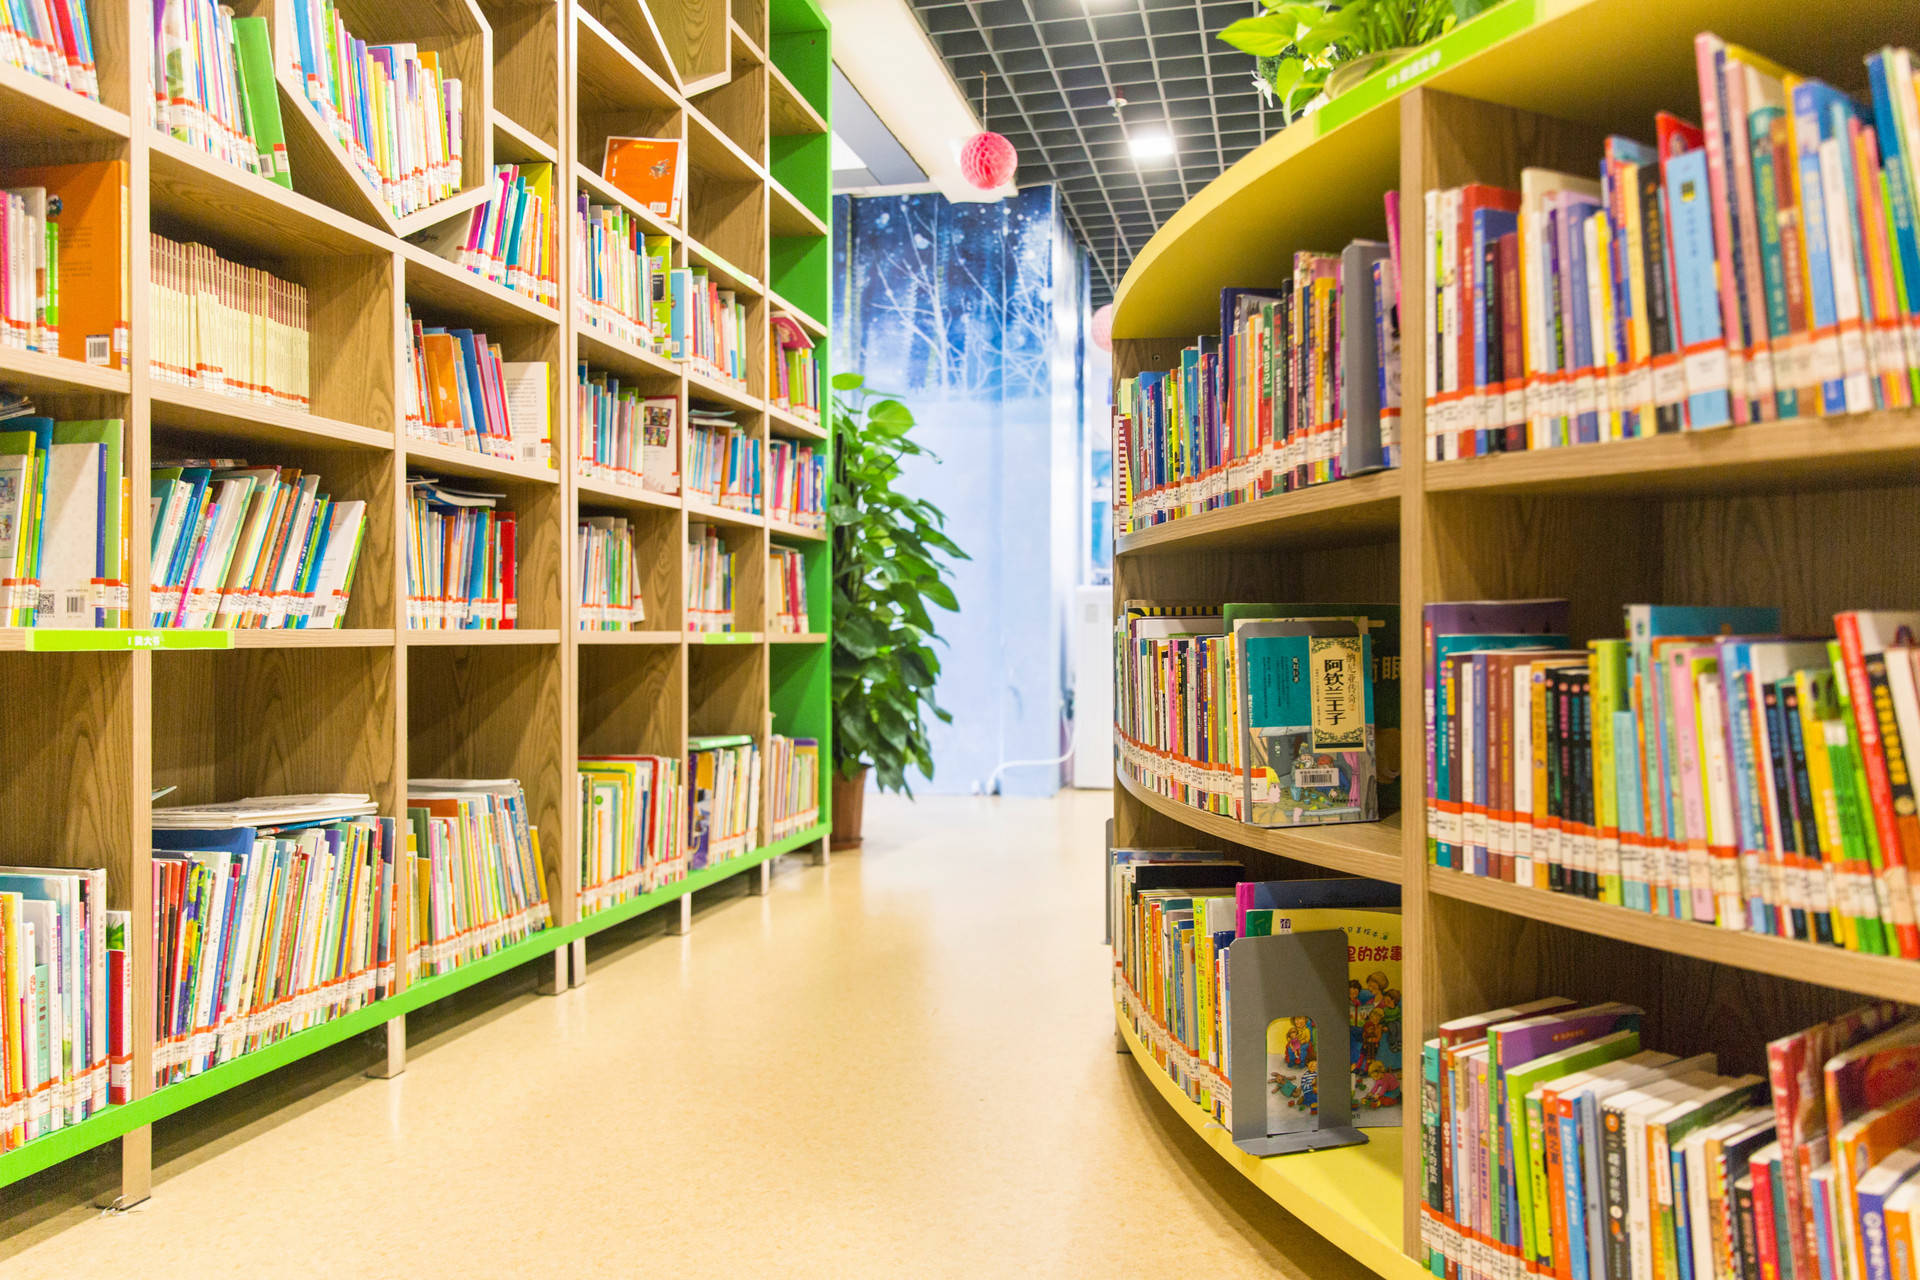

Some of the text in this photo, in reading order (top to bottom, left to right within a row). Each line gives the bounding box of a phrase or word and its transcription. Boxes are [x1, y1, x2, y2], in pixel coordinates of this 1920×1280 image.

[1323, 659, 1347, 726] 阿钦兰王子
